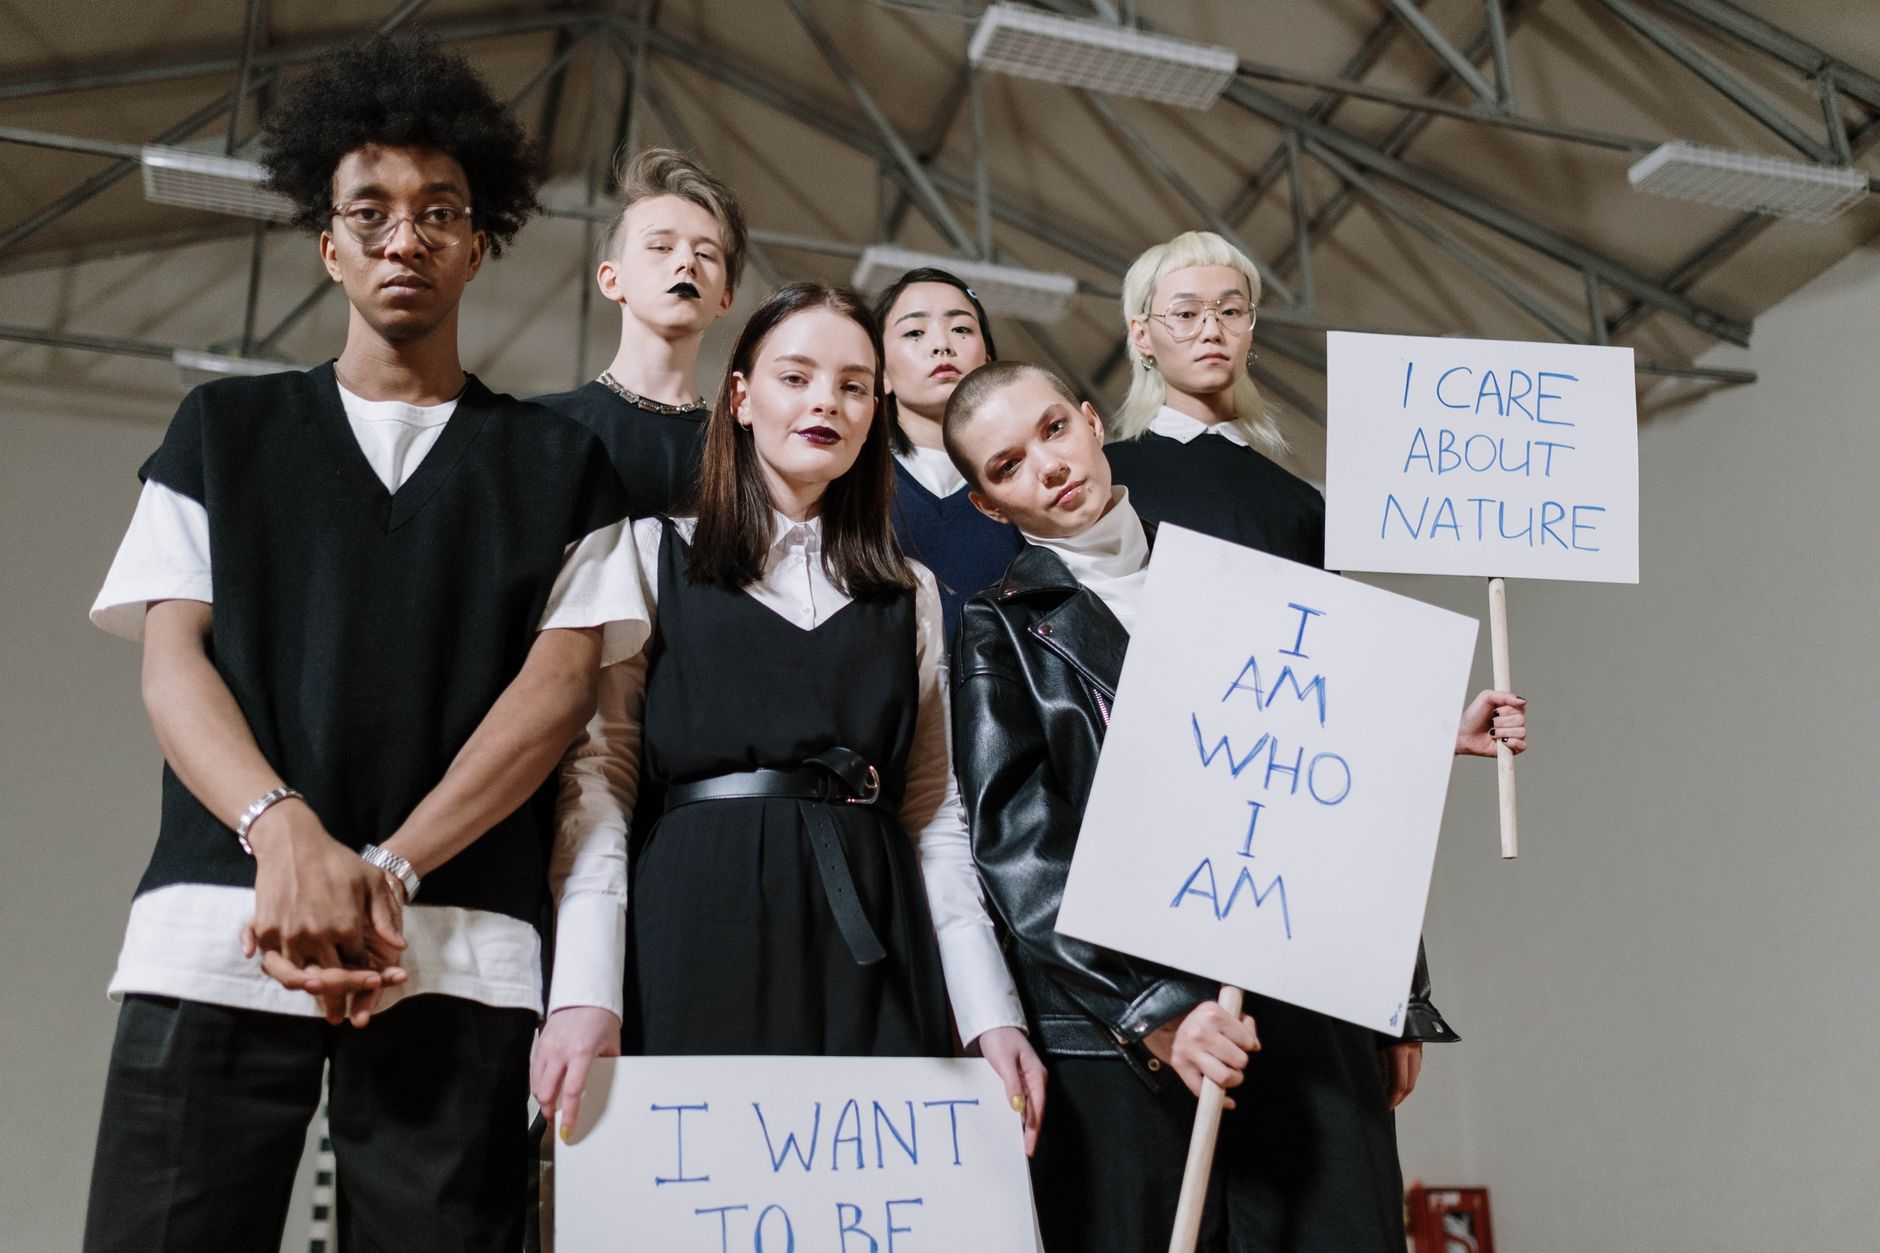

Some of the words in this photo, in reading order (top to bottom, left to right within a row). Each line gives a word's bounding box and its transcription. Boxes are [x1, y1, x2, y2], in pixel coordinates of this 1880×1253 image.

[1403, 361, 1414, 409] I
[1436, 365, 1580, 427] CARE
[1403, 426, 1576, 478] ABOUT
[1380, 493, 1607, 552] NATURE
[1278, 601, 1327, 659] I
[1221, 655, 1327, 728] AM
[1191, 712, 1352, 806] WHO
[1236, 800, 1266, 859] I
[1170, 857, 1292, 940] AM
[650, 1102, 710, 1186] I
[751, 1098, 980, 1172] WANT
[694, 1203, 796, 1253] TO
